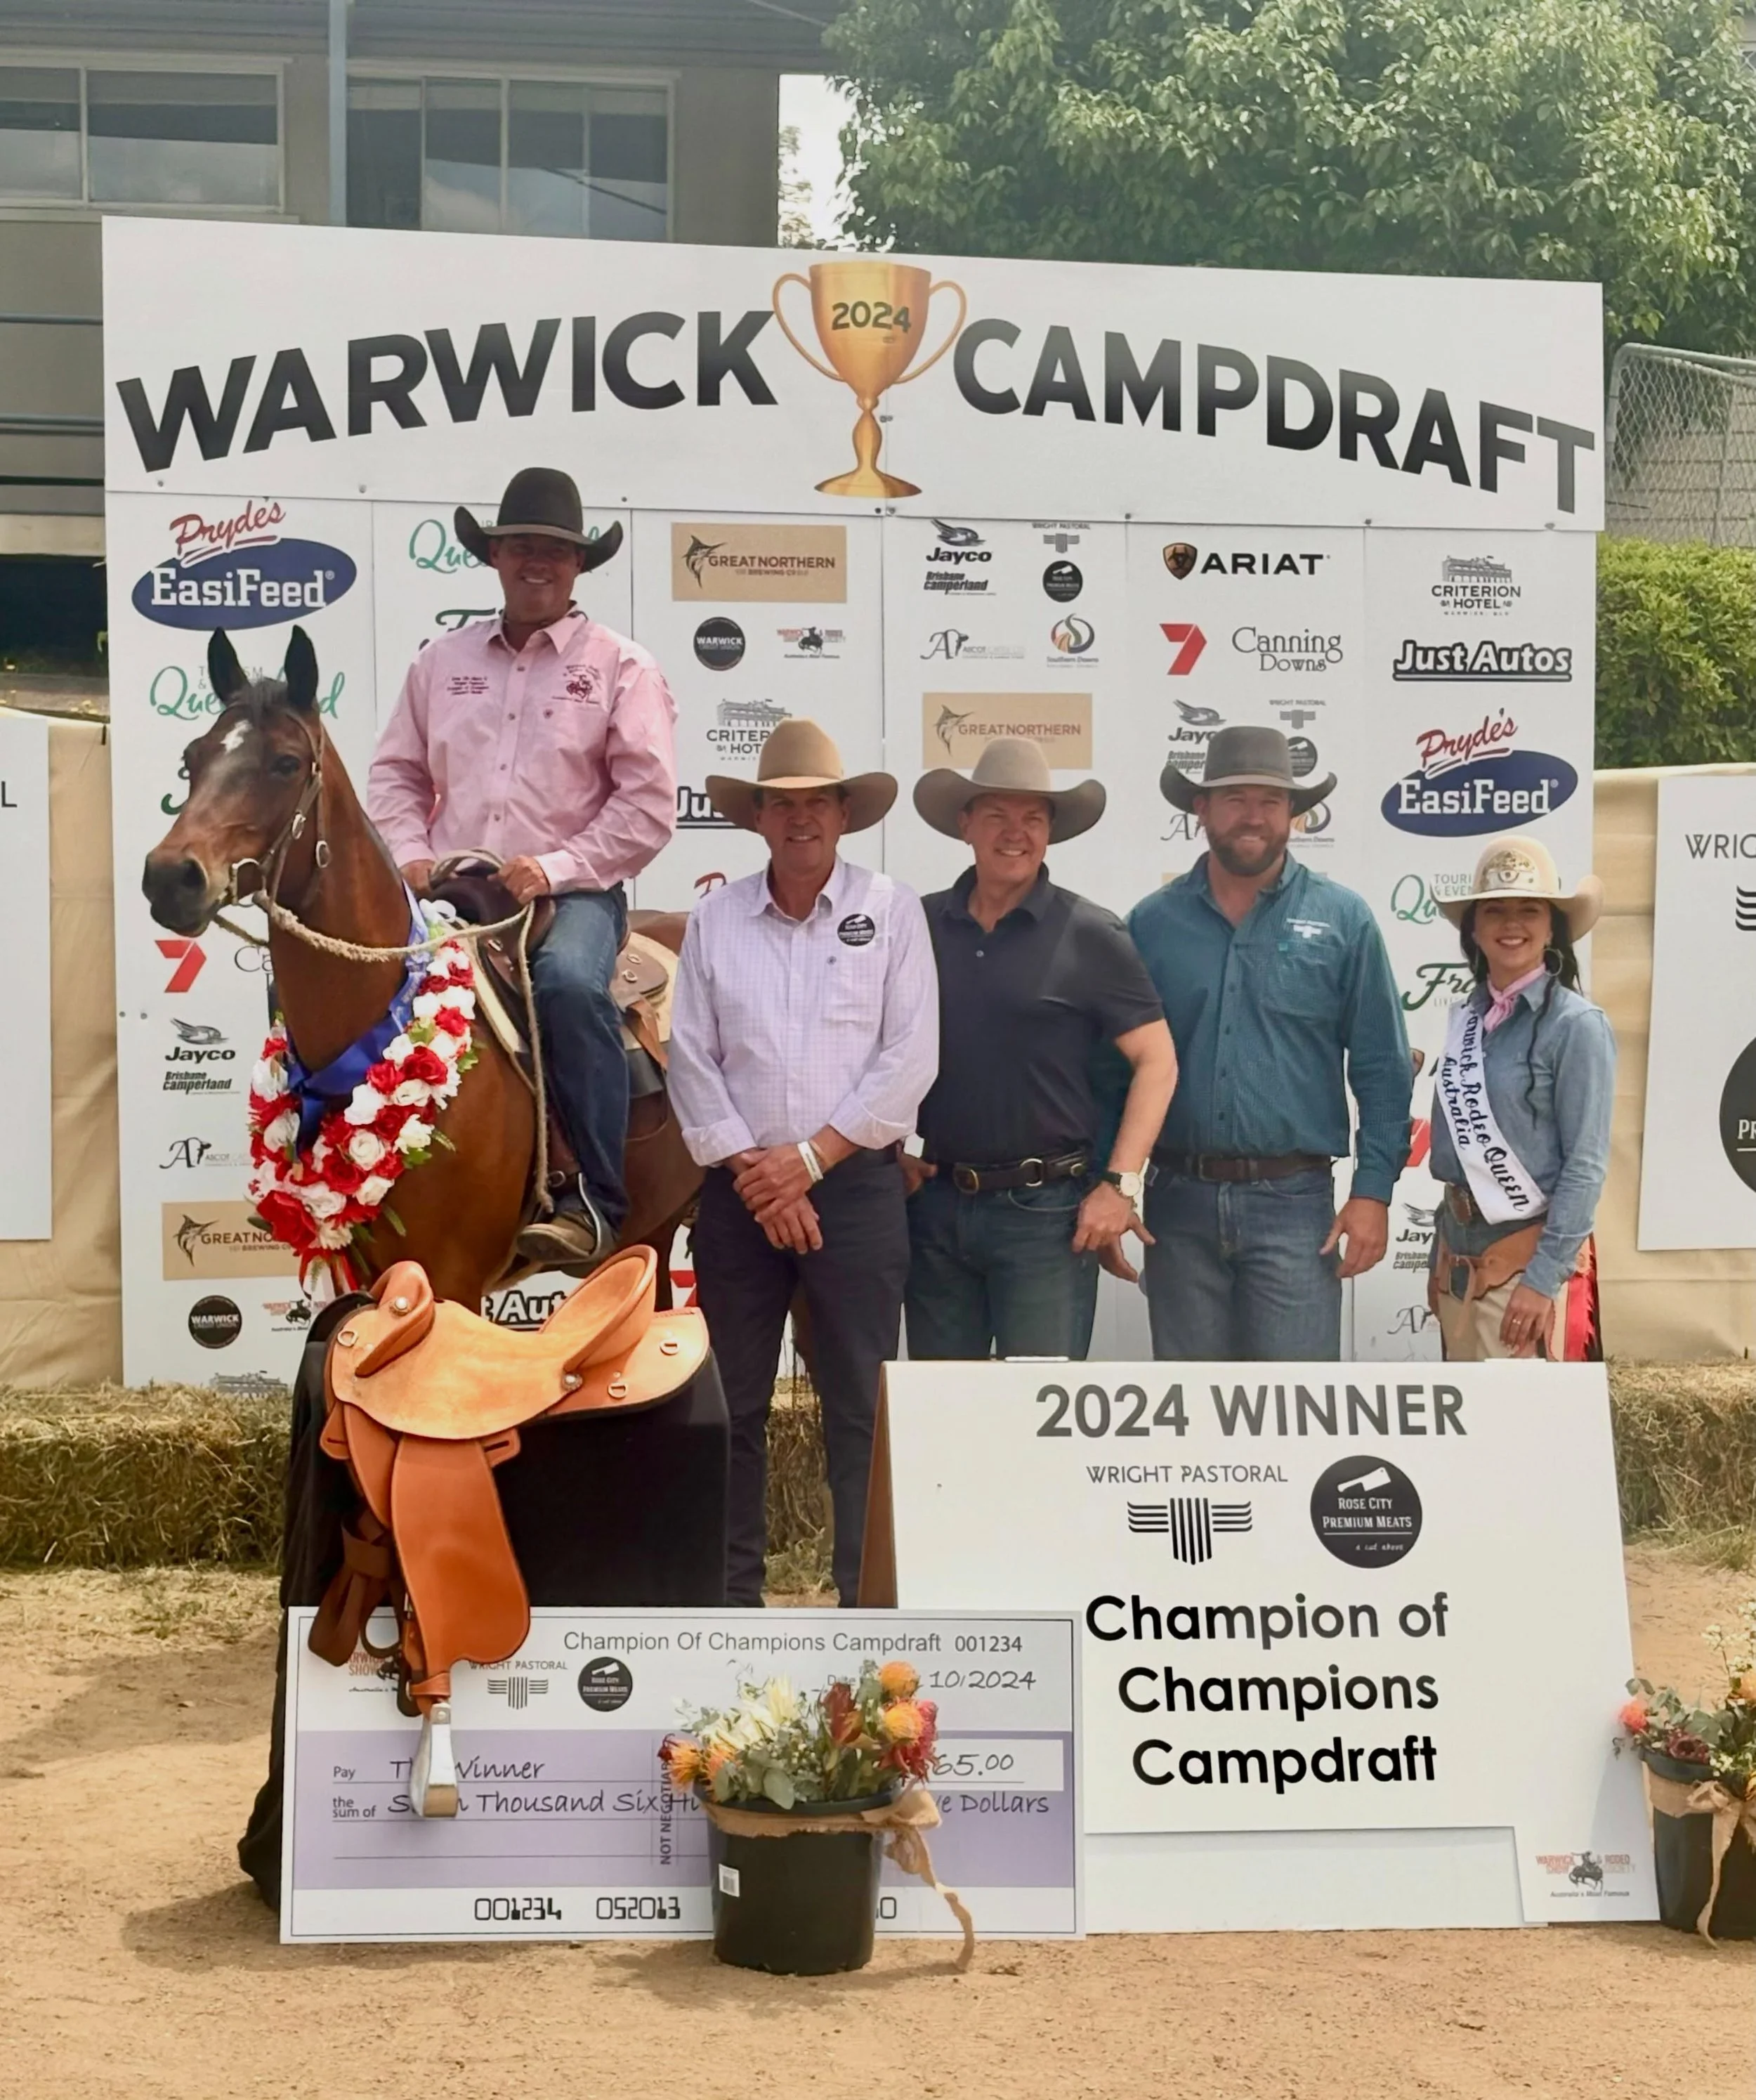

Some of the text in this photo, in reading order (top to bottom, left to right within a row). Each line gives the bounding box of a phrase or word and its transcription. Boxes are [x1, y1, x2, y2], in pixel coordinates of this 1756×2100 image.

[117, 301, 1596, 514] WARWICK 2024 CAMPDRAFT
[169, 497, 287, 556] Pryde's
[926, 547, 992, 565] Jayco
[1200, 553, 1324, 575] ARIAT
[926, 571, 965, 581] Brisbane
[1431, 585, 1521, 598] CRITERION
[1453, 599, 1501, 609] HOTEL
[696, 637, 742, 645] WARWICK
[1231, 627, 1344, 664] Canning
[1259, 653, 1327, 672] Downs
[706, 729, 770, 742] CRITER
[1167, 726, 1217, 745] Jayc
[1416, 707, 1519, 769] Pryde's
[730, 743, 761, 754] HOT
[1434, 874, 1472, 884] TOURI
[1445, 886, 1473, 896] EVEN
[164, 1046, 236, 1064] Jayco
[165, 1071, 207, 1080] Brisbane
[1440, 1053, 1471, 1150] Australia
[1460, 1078, 1491, 1148] Rodeo
[1483, 1146, 1531, 1212] Queen
[201, 1232, 251, 1244] GREAT
[1396, 1228, 1434, 1245] Jay
[1395, 1251, 1430, 1260] Brisban
[497, 1289, 568, 1324] Aut
[190, 1313, 239, 1324] WARWICK
[1035, 1383, 1468, 1439] 2024 WINNER
[1086, 1465, 1288, 1484] WRIGHT PASTORAL
[1337, 1497, 1393, 1510] ROSE CITY
[1322, 1515, 1413, 1529] PREMIUM MEATS
[1085, 1591, 1449, 1650] Champion of
[563, 1631, 1023, 1657] Champion Of Champions Campdraft 001234
[515, 1660, 568, 1670] PASTORAL
[1118, 1664, 1439, 1721] Champions
[333, 1766, 356, 1780] Pay
[931, 1754, 1014, 1776] 65.00
[1132, 1735, 1438, 1794] Campdraft
[332, 1796, 354, 1808] the
[476, 1791, 605, 1813] Thousand
[612, 1789, 660, 1814] Six
[959, 1791, 1049, 1813] Dollars
[332, 1805, 377, 1818] sum of
[660, 1837, 672, 1865] NOT
[474, 1897, 562, 1921] 001234
[596, 1896, 681, 1920] 052013
